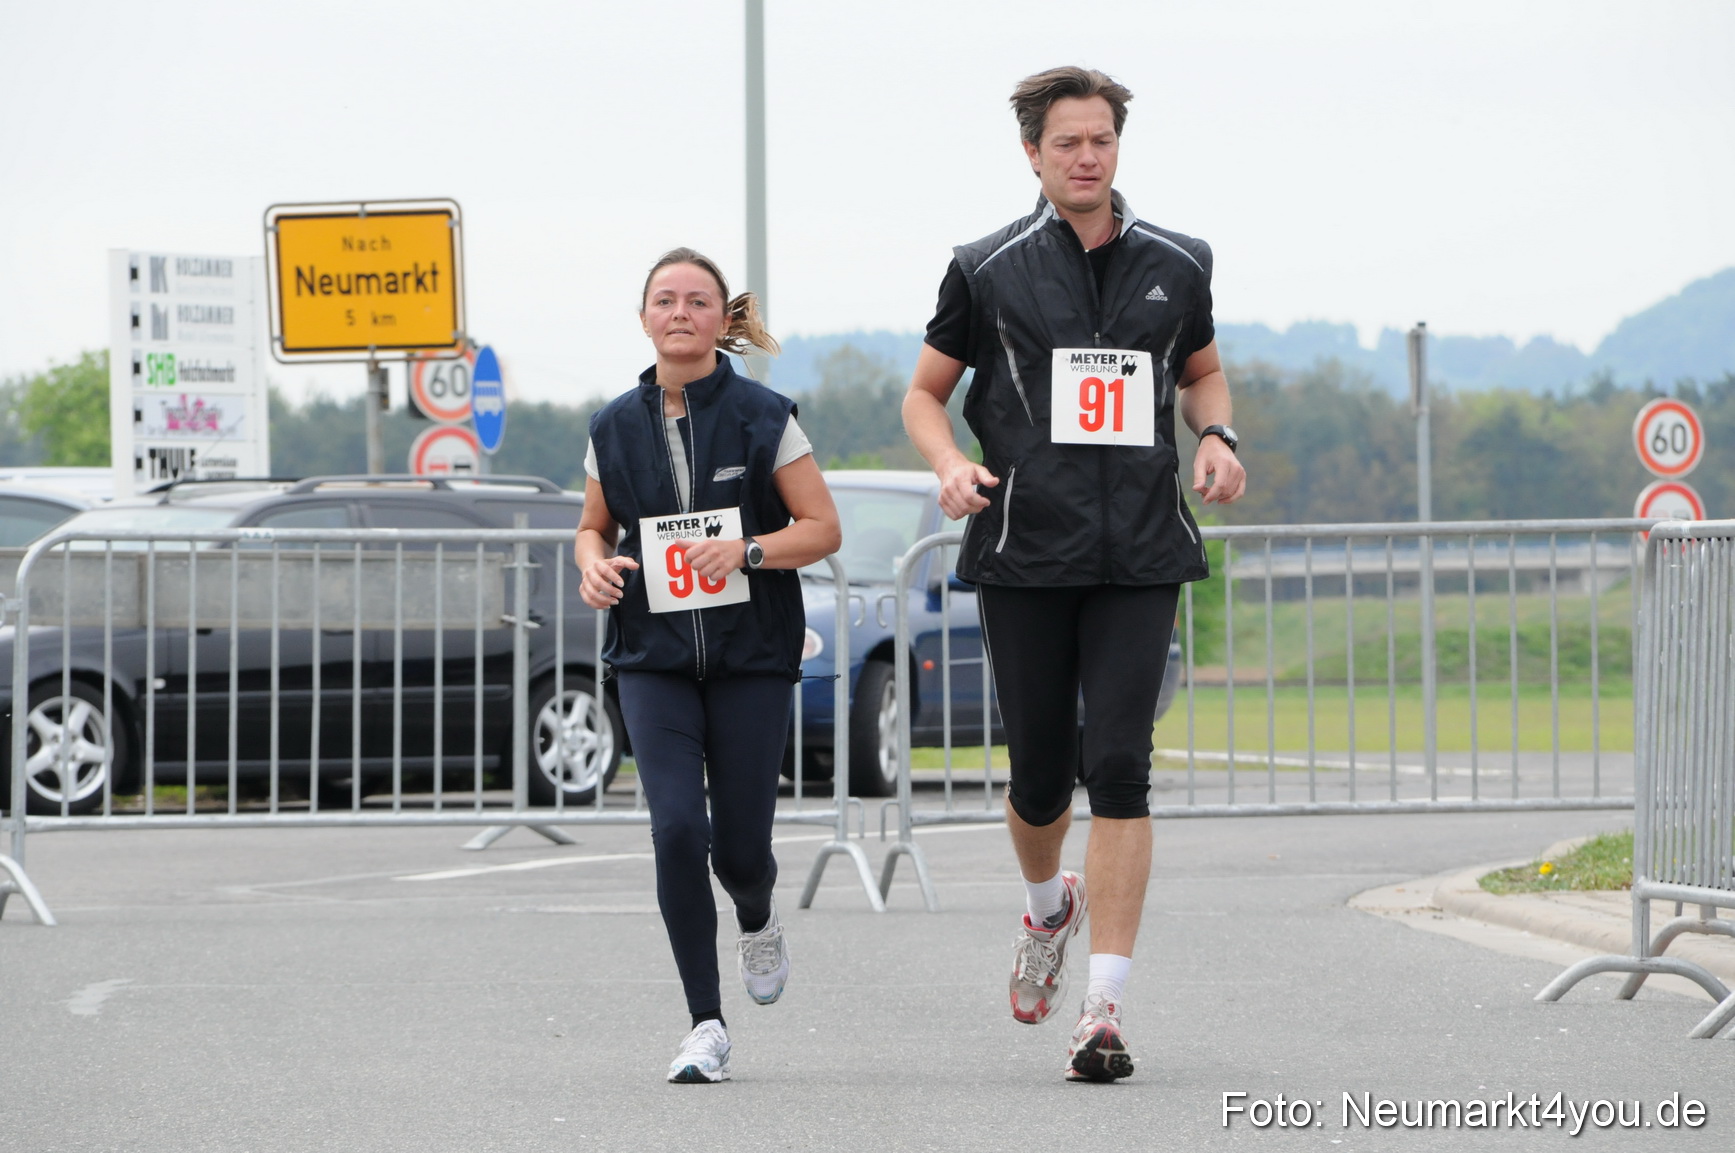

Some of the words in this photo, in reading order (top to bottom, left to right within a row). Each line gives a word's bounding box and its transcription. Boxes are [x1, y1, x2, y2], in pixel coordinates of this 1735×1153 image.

[341, 235, 392, 252] Nach
[295, 261, 440, 297] Neumarkt
[344, 308, 356, 327] 5
[370, 311, 397, 327] km
[1070, 353, 1118, 365] MEYER
[1070, 364, 1119, 374] WERBUNG
[429, 362, 469, 399] 60
[1079, 376, 1124, 433] 91
[1652, 422, 1687, 455] 60
[656, 518, 701, 533] MEYER
[656, 529, 703, 541] WERBUNG
